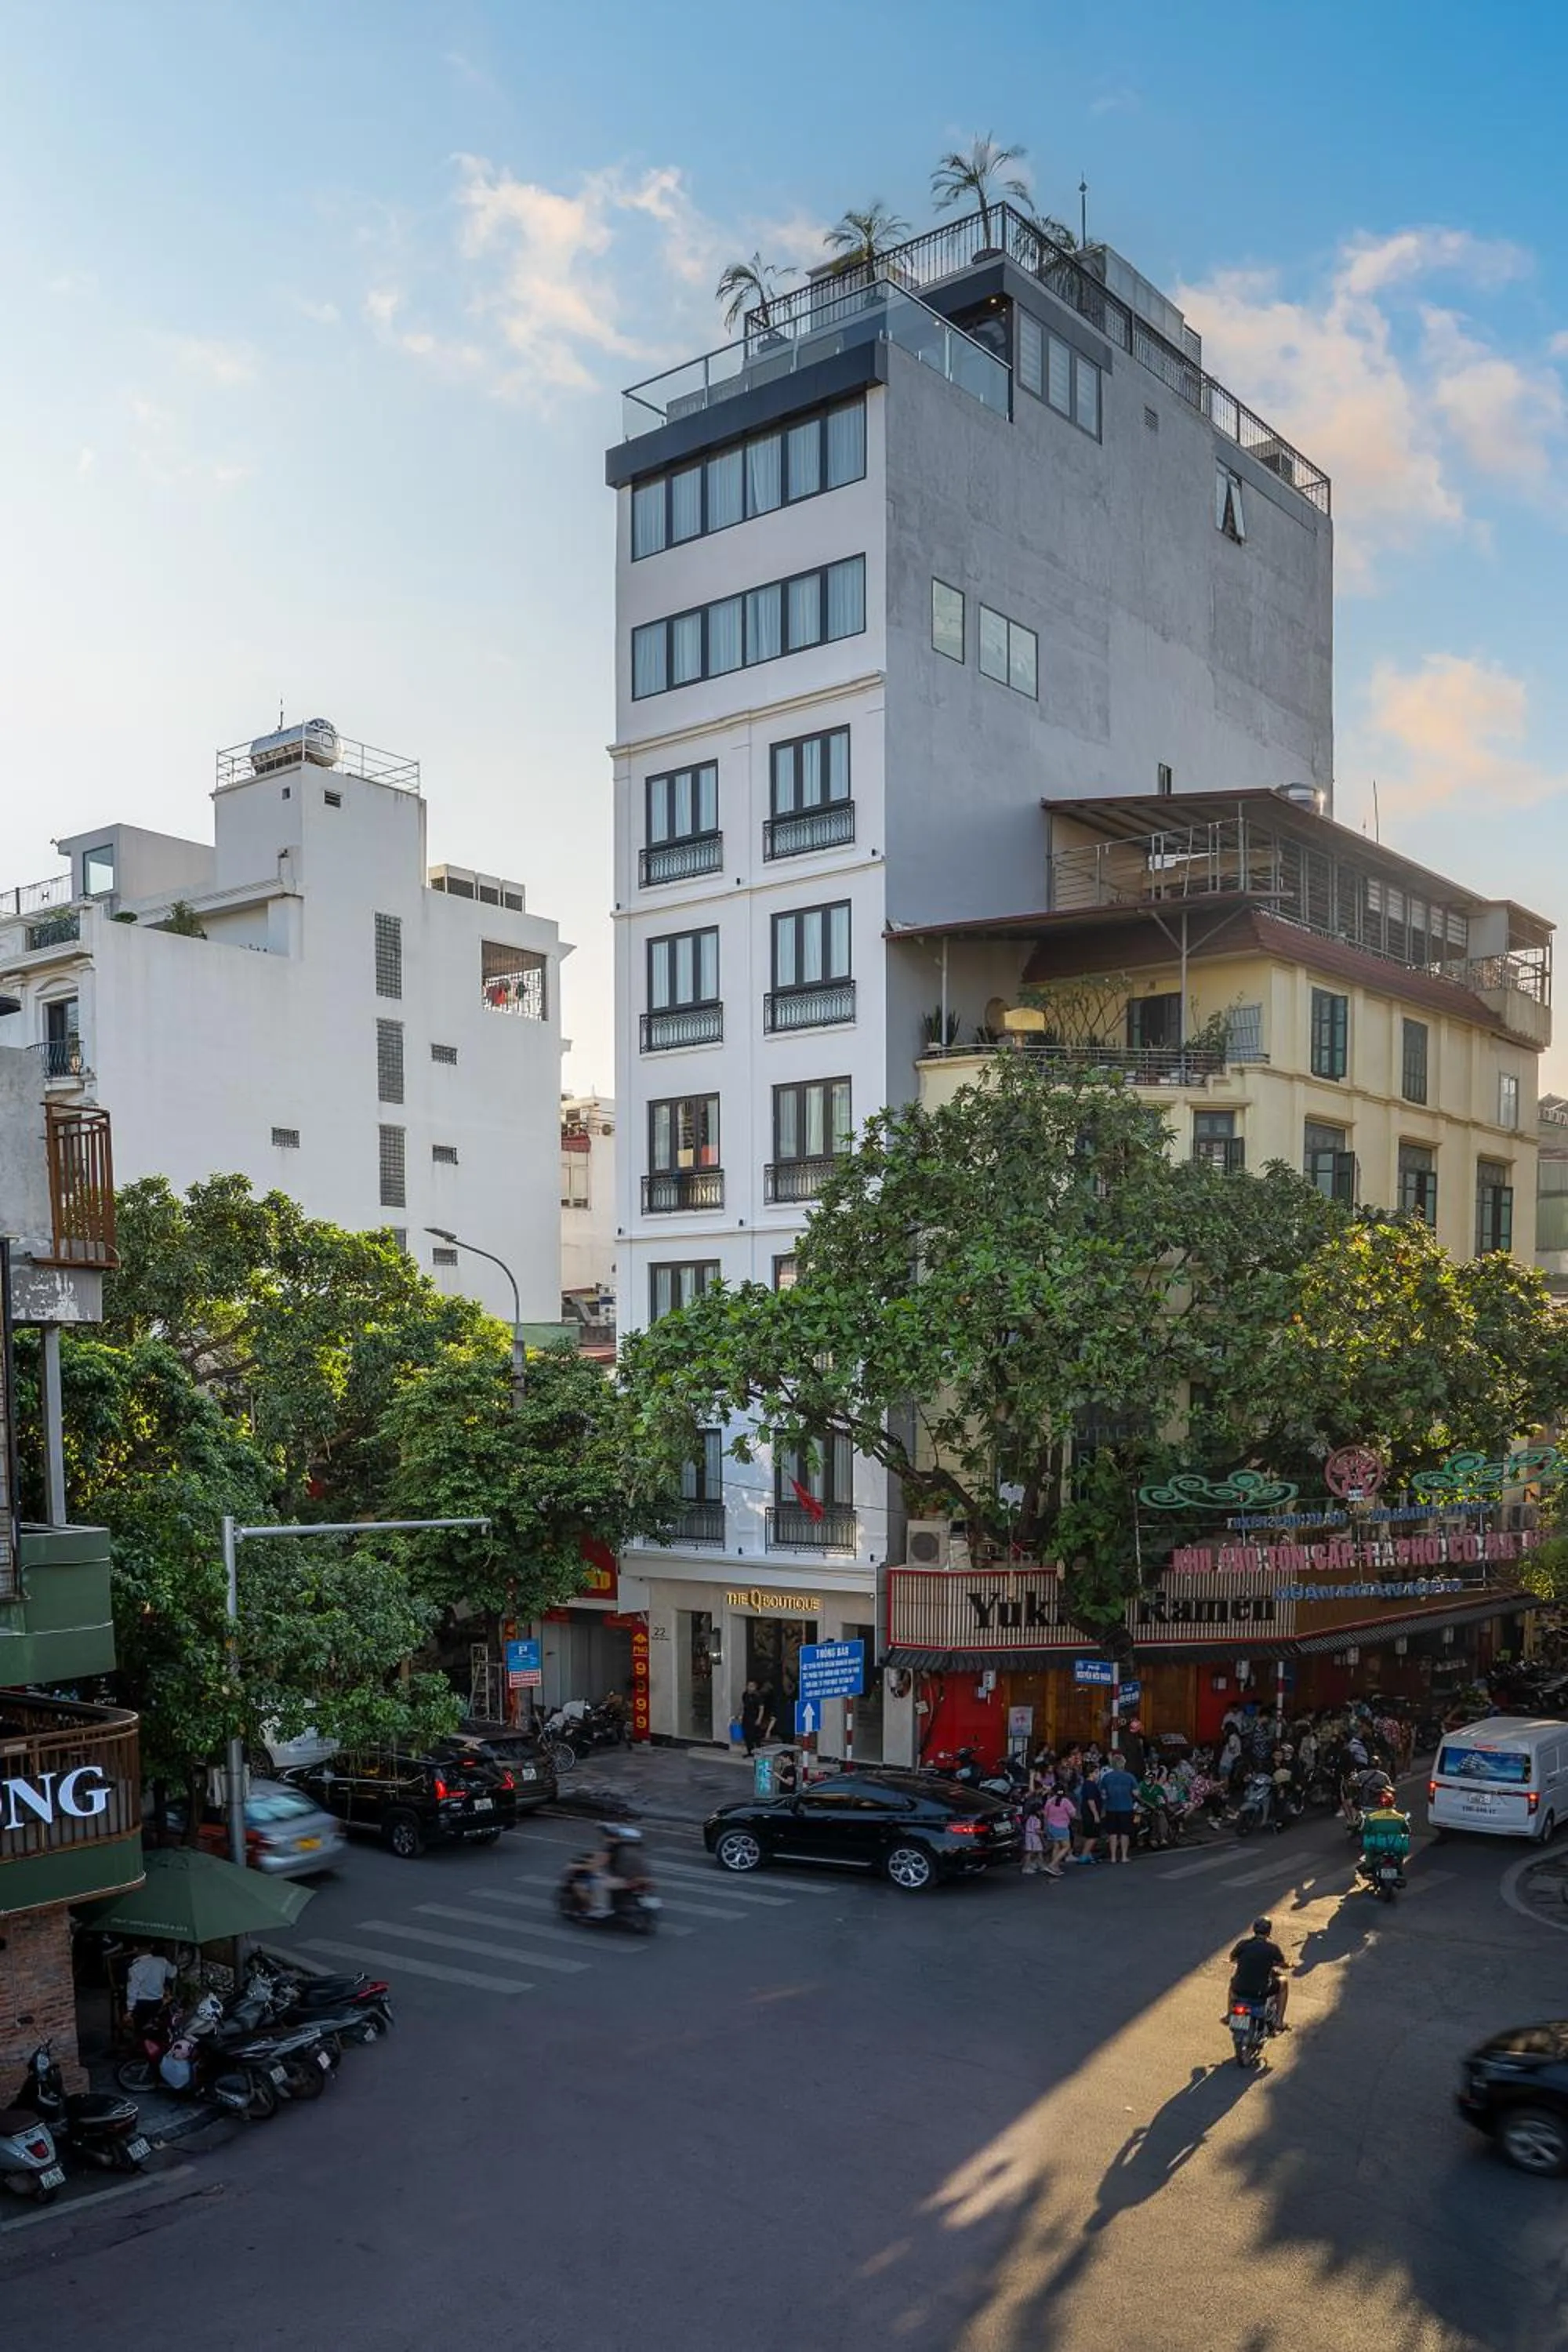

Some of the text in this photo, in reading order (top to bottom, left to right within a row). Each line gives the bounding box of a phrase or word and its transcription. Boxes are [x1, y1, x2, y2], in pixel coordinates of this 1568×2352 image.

[727, 1592, 749, 1606] THE
[762, 1593, 821, 1611] BOUTIQUE
[967, 1592, 1069, 1628] Yuk
[654, 1627, 666, 1636] 22
[0, 1766, 111, 1830] NG
